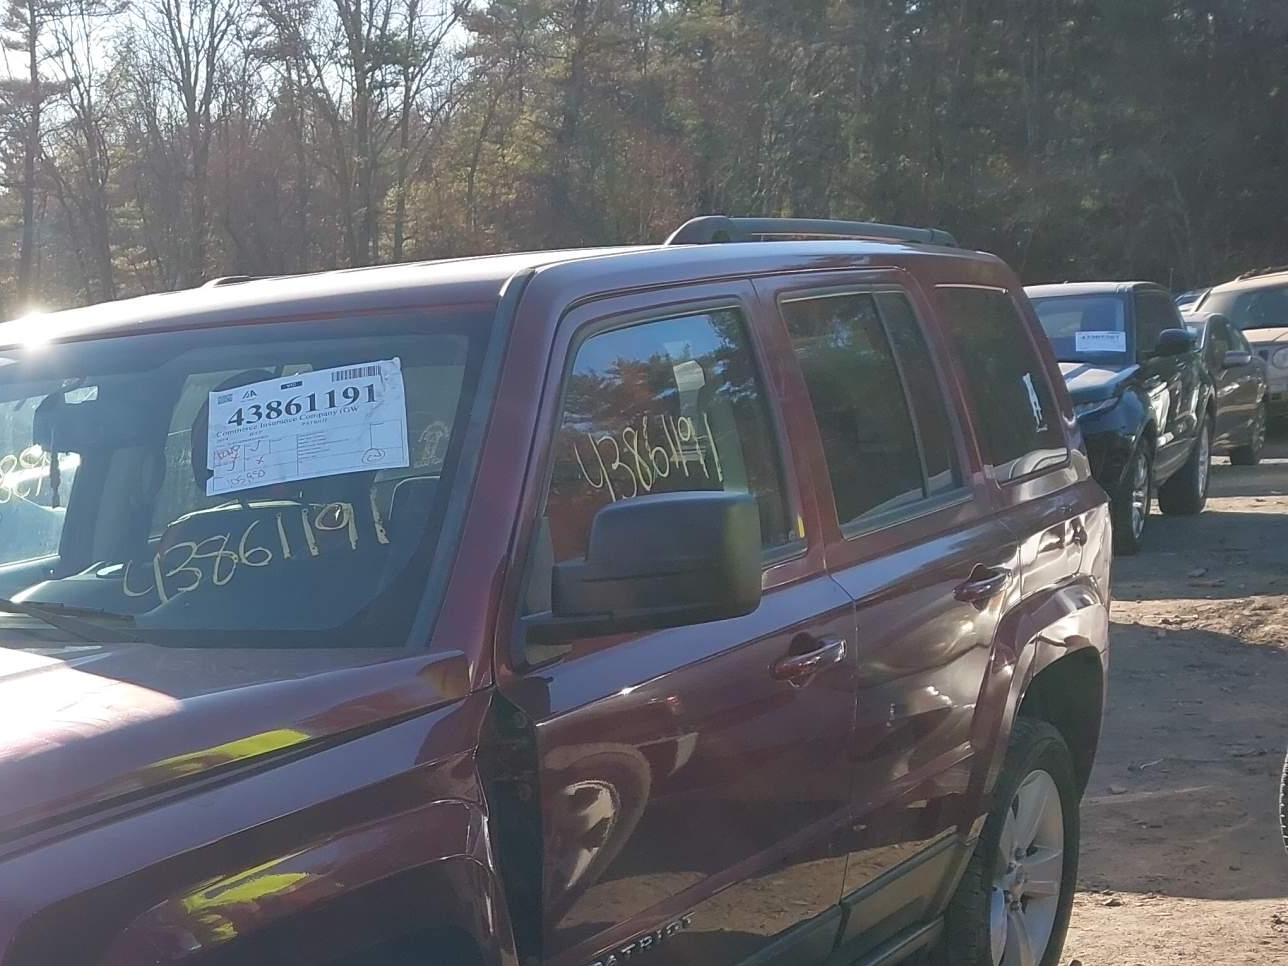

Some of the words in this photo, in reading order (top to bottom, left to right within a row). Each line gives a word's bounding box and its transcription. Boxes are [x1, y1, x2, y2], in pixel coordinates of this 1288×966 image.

[227, 384, 376, 426] 43861191
[300, 409, 337, 421] Company
[574, 413, 723, 502] 43861191
[122, 486, 390, 601] 43861191
